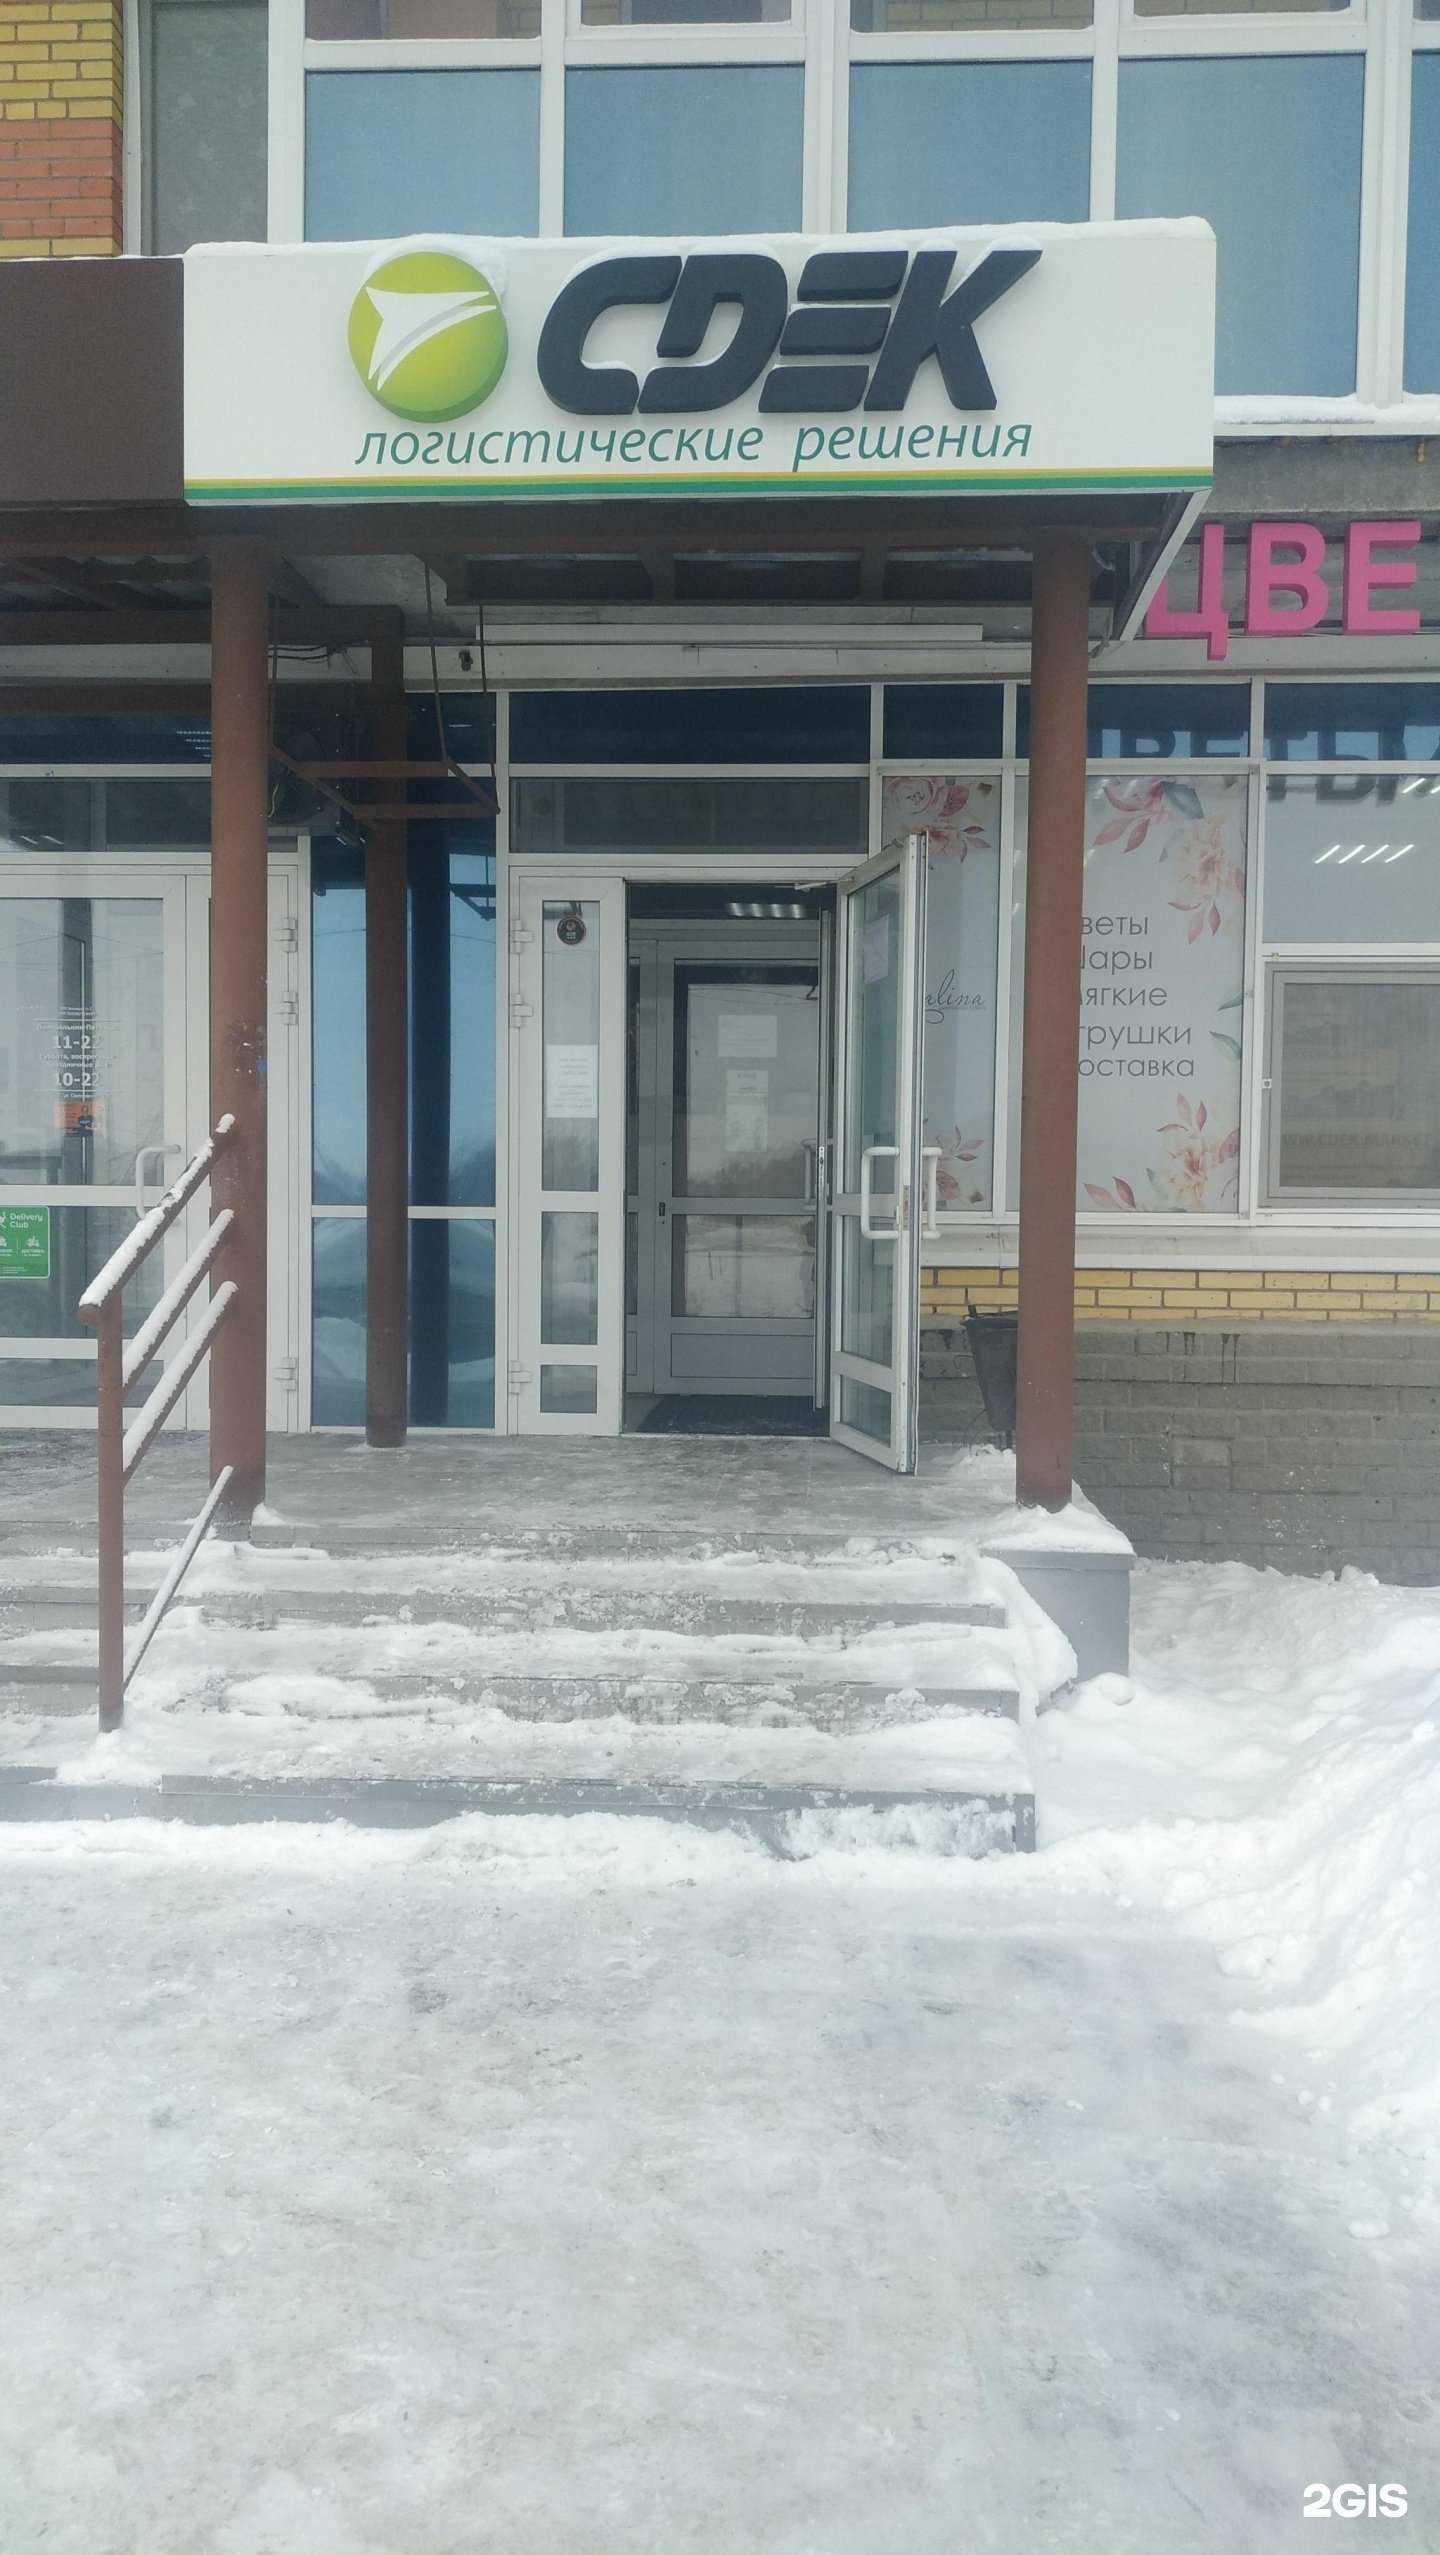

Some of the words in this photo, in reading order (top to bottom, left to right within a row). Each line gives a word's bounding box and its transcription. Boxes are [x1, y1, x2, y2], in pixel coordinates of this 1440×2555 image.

[355, 426, 764, 465] логистические
[792, 424, 1032, 473] решения
[1081, 916, 1149, 936] веты
[1080, 987, 1168, 1007] ягкие
[1078, 1026, 1192, 1051] рушки
[1078, 1059, 1195, 1077] оставка
[10, 1212, 44, 1223] Delivery
[10, 1221, 30, 1229] Club
